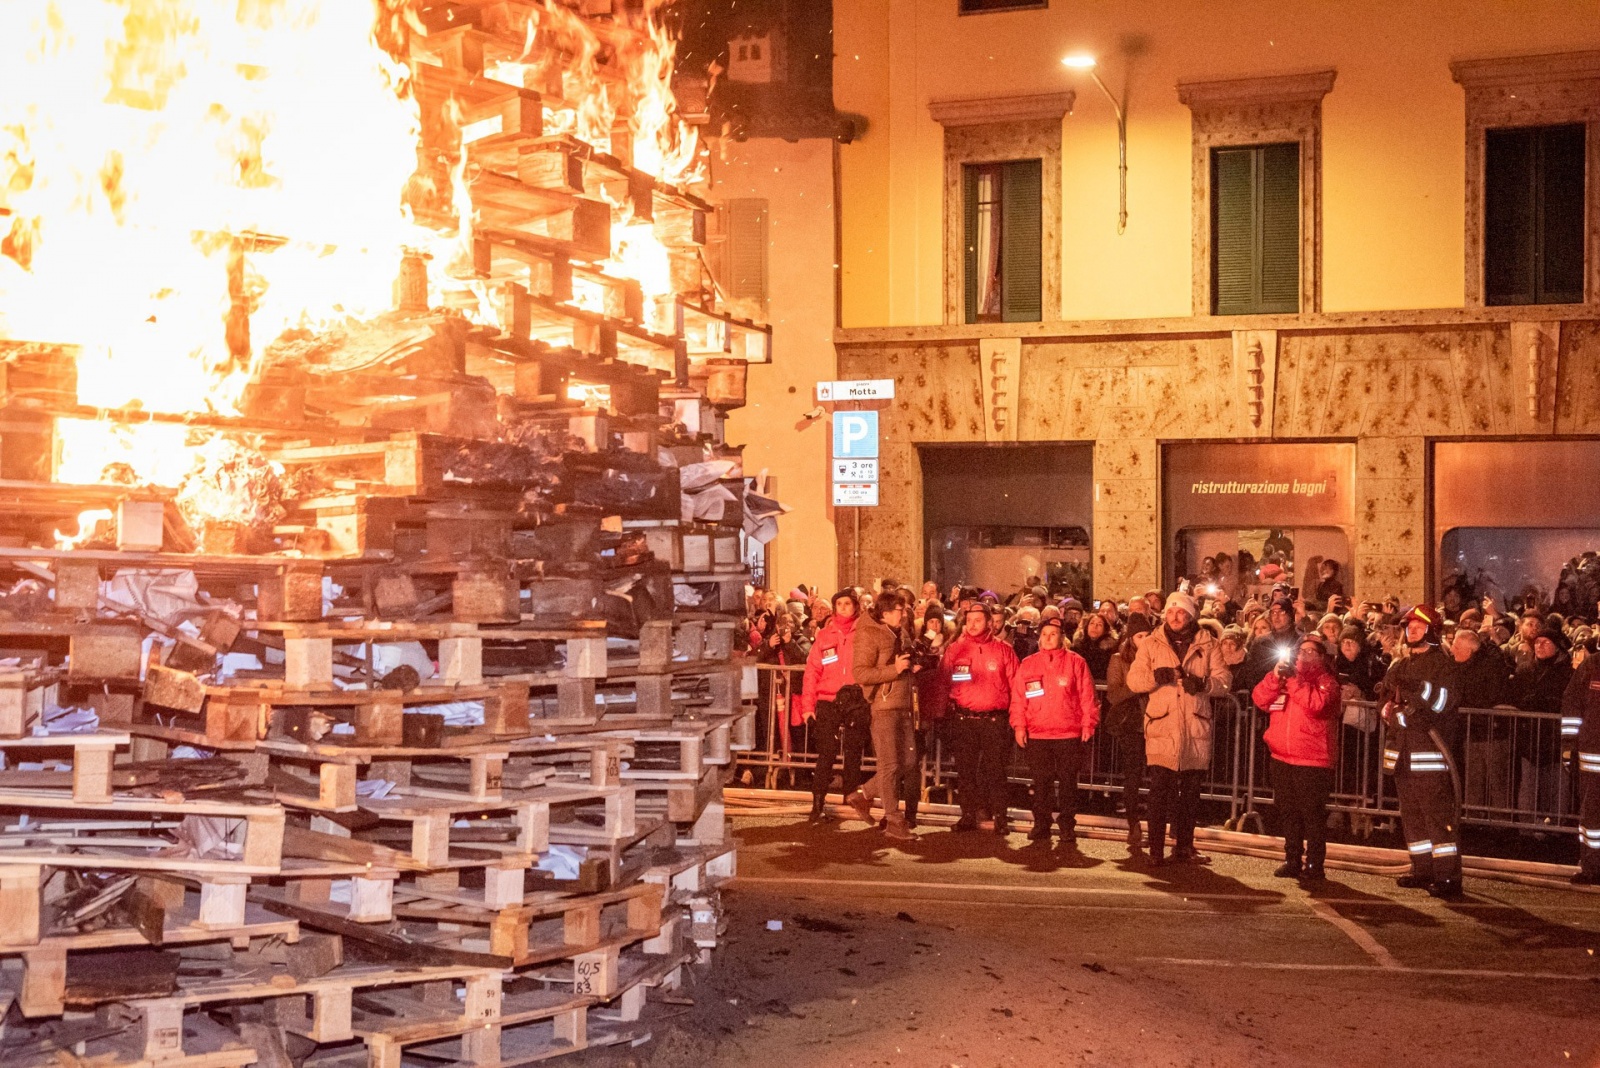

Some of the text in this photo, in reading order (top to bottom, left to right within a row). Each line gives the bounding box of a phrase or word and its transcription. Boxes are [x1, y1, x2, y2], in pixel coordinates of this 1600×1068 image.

[849, 388, 877, 396] Motta
[843, 416, 868, 453] P
[852, 461, 858, 469] 3
[1191, 479, 1327, 497] ristrutturazione bagni
[578, 961, 601, 976] 60,5
[487, 989, 495, 998] 59
[576, 982, 592, 994] 83
